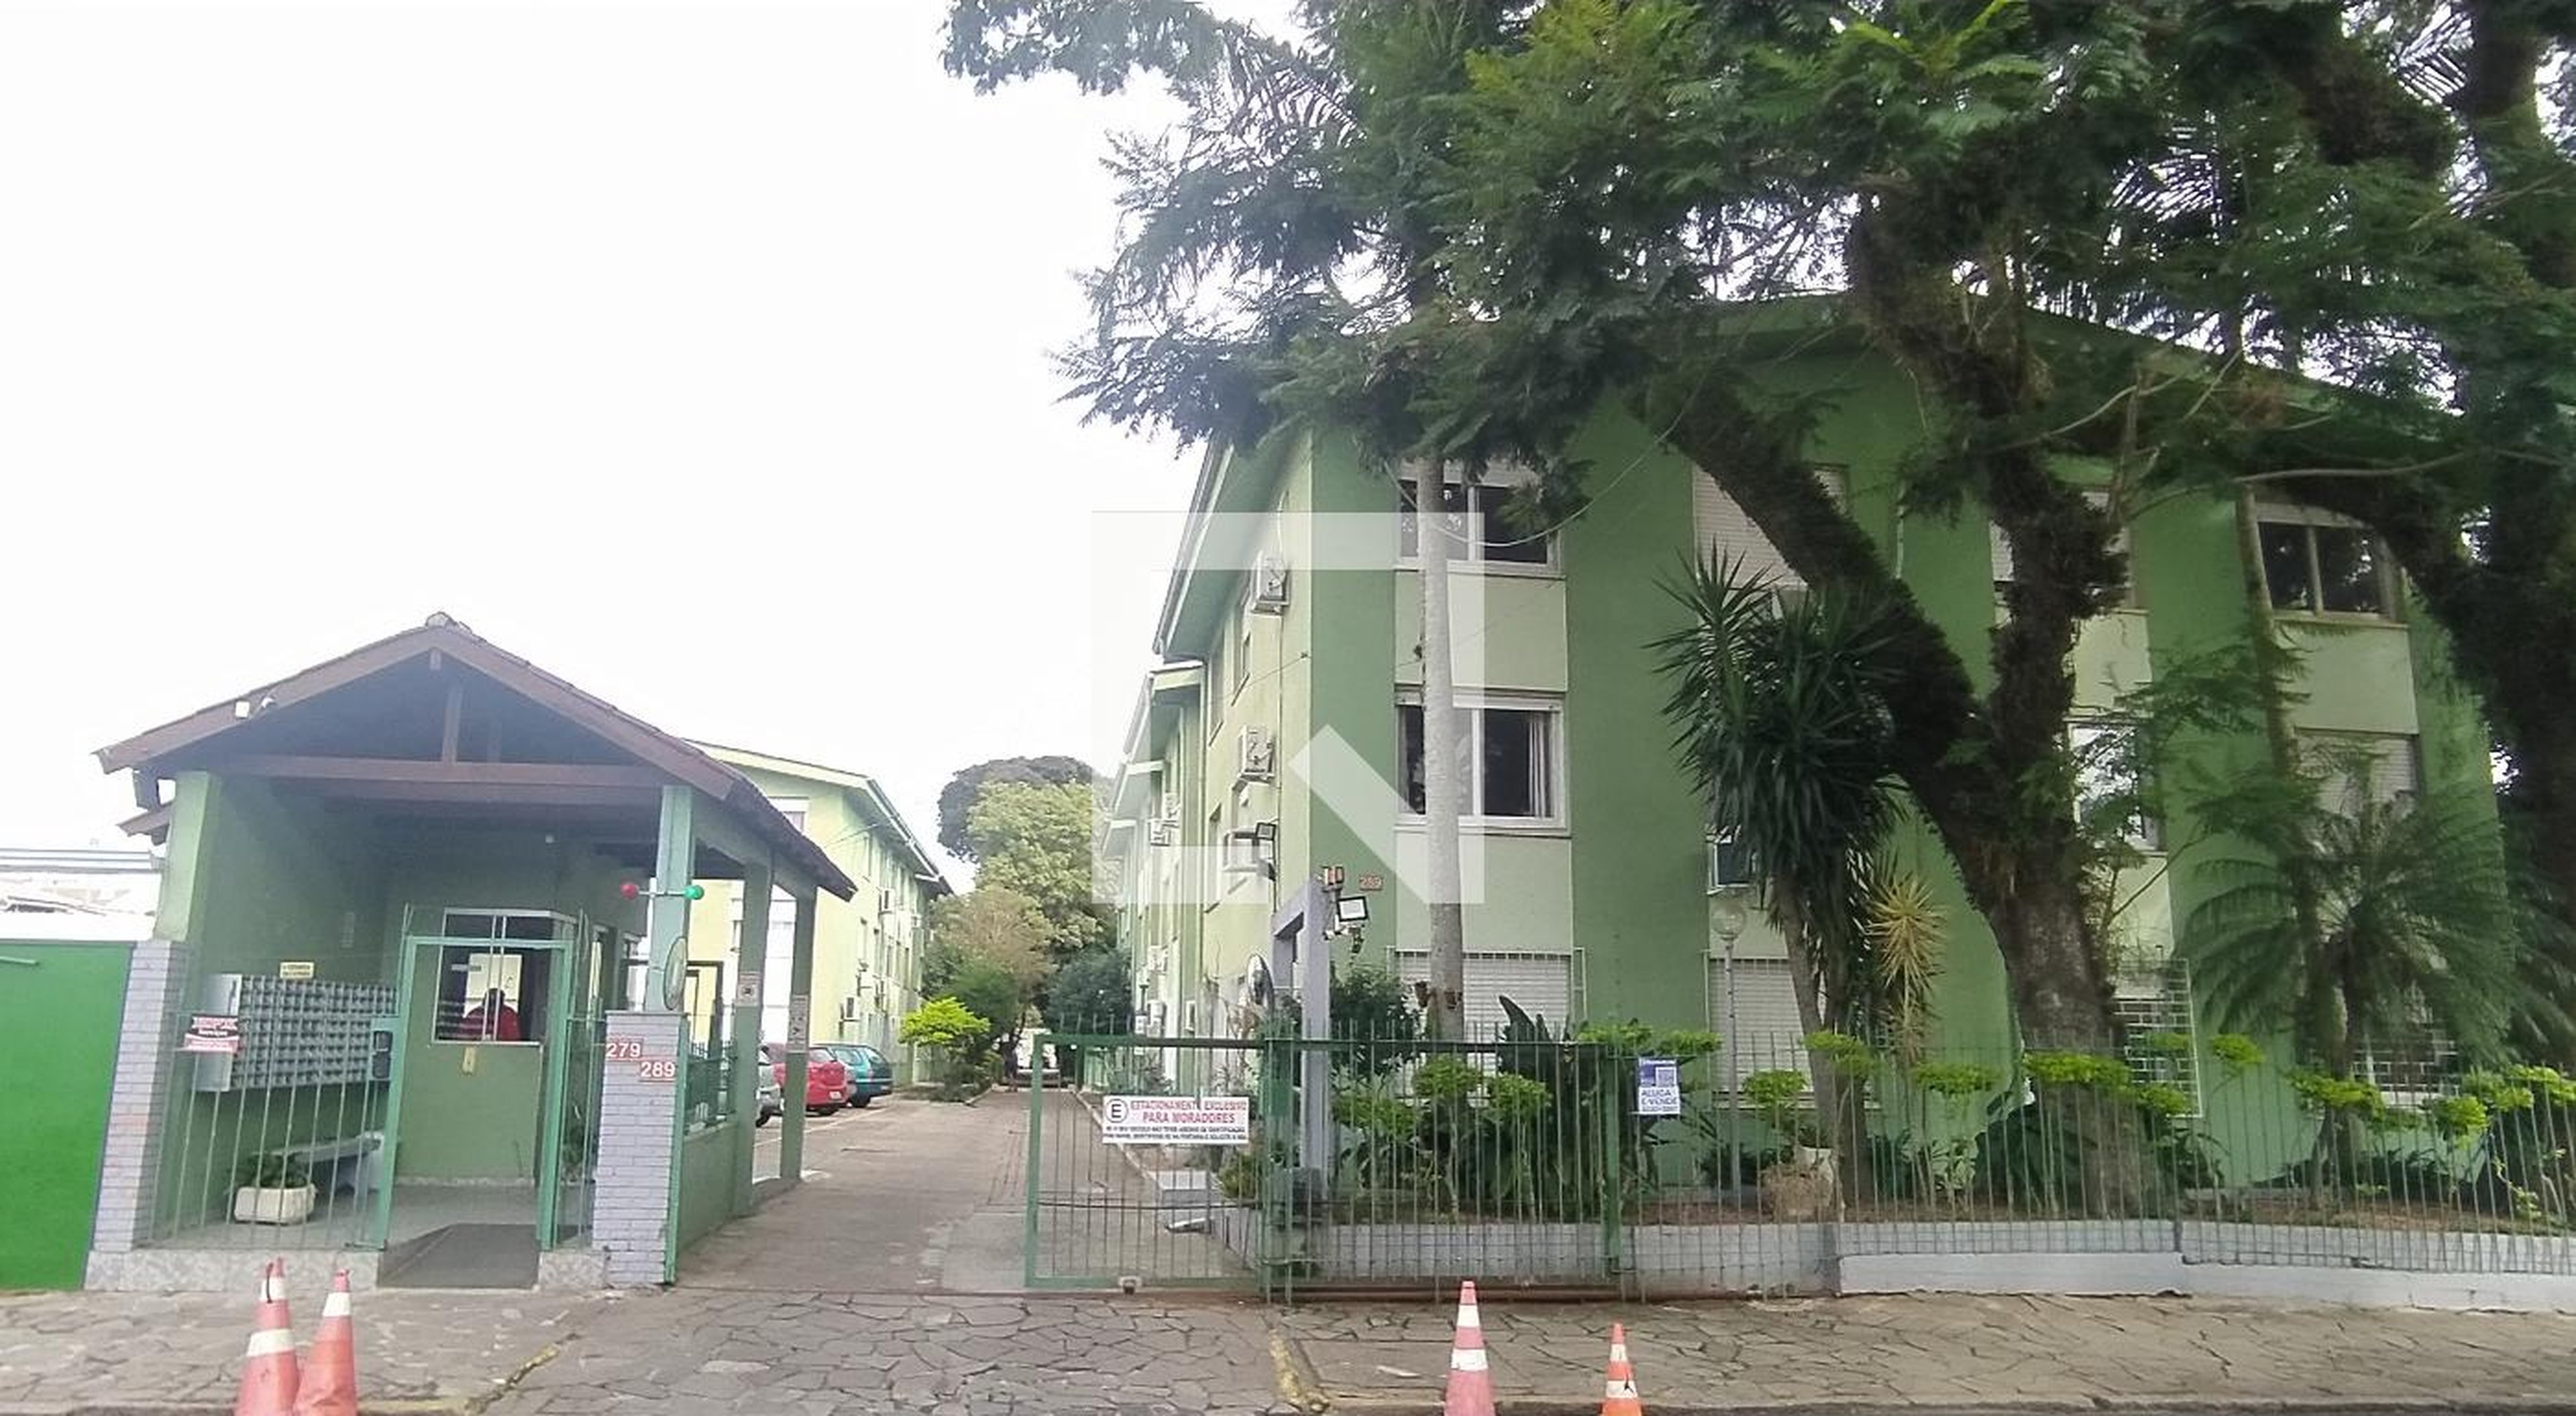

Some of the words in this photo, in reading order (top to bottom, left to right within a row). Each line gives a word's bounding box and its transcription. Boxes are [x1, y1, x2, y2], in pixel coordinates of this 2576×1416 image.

[606, 1043, 641, 1057] 279
[641, 1061, 676, 1077] 289
[1111, 1103, 1122, 1118] E
[1130, 1100, 1199, 1110] ESTACIONAMENT
[1142, 1111, 1169, 1124] PARA
[1172, 1111, 1235, 1124] MORADORES
